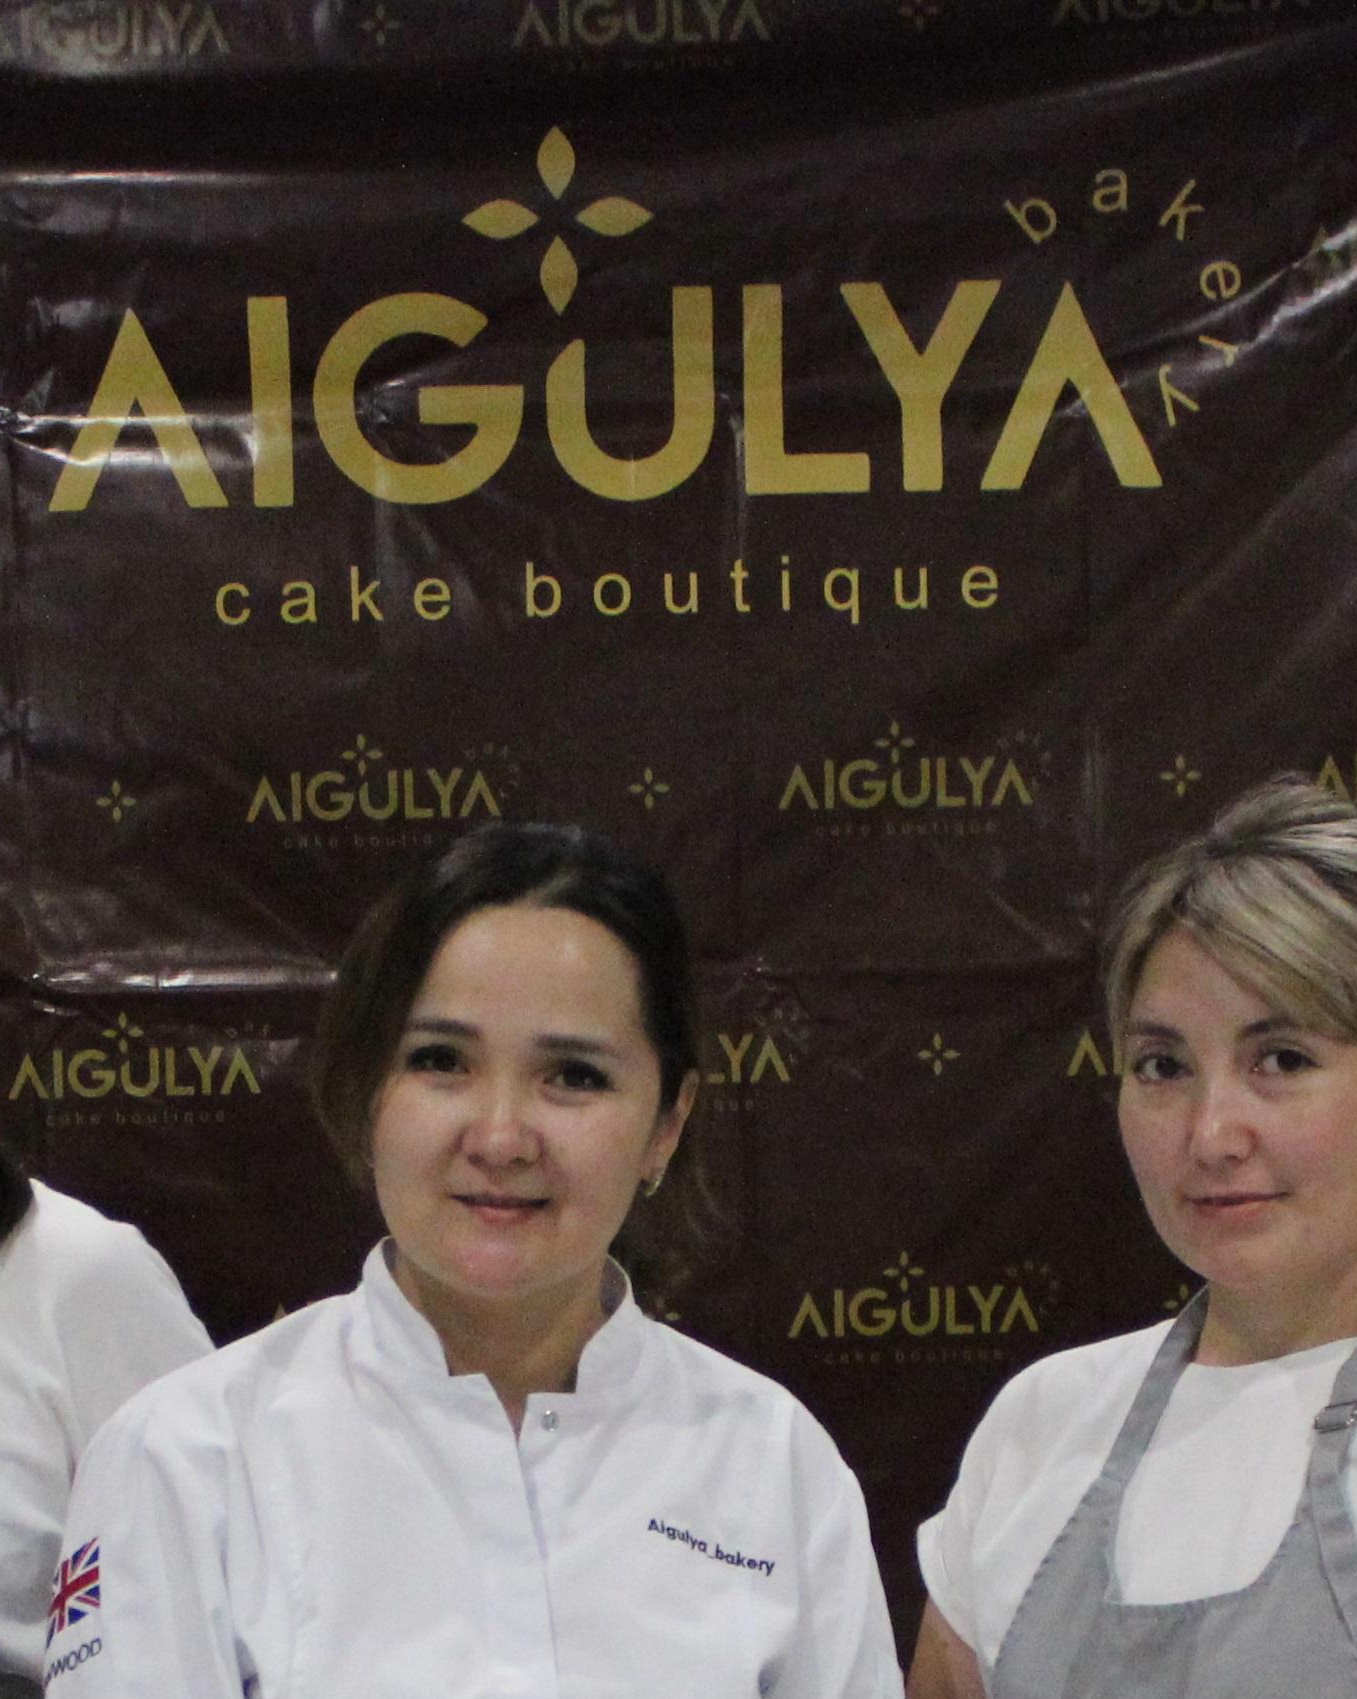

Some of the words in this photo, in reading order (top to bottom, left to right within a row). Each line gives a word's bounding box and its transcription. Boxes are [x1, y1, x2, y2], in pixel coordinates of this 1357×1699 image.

[511, 0, 771, 47] AIGULYA
[1005, 168, 1242, 426] bakery
[48, 279, 1164, 511] AIGULYA
[215, 566, 451, 625] cake
[525, 556, 1000, 625] boutique
[246, 767, 502, 823] AIGULYA
[778, 756, 1034, 811] AIGULYA
[8, 1046, 262, 1101] AIGULYA
[787, 1284, 1041, 1339] AIGULYA
[44, 1637, 102, 1689] WOOD
